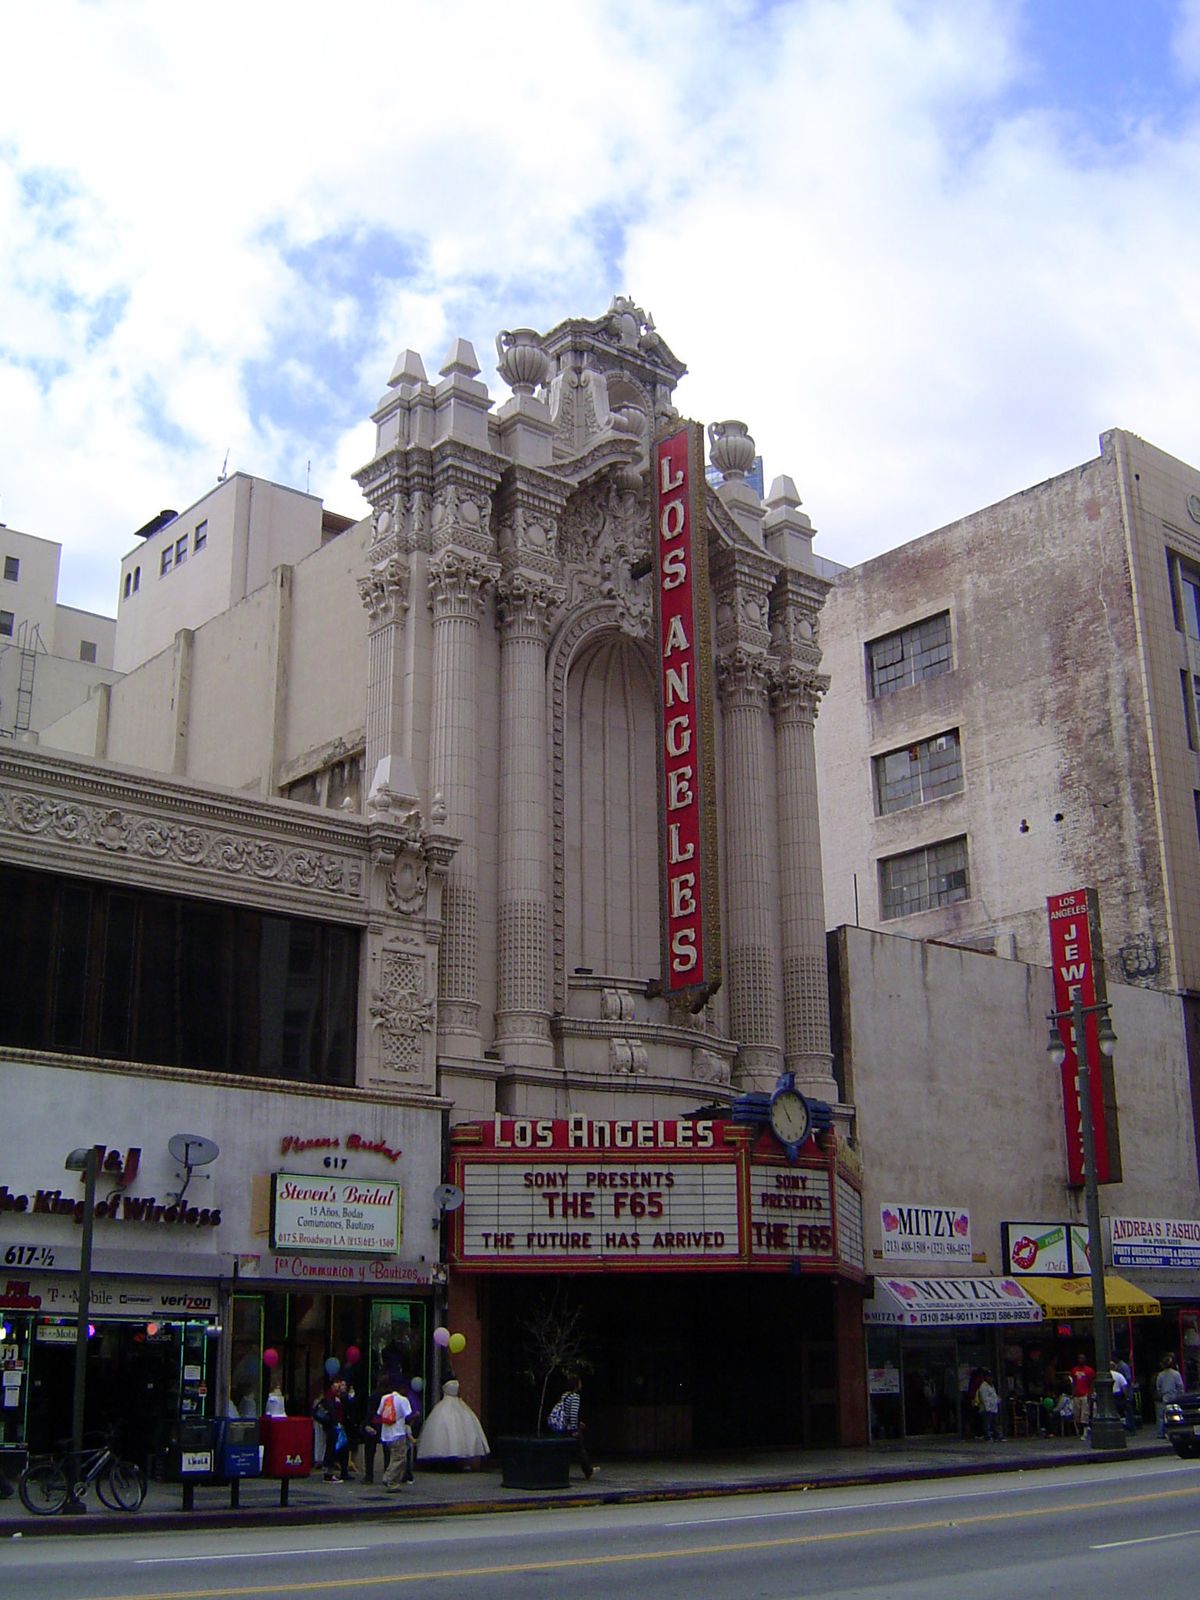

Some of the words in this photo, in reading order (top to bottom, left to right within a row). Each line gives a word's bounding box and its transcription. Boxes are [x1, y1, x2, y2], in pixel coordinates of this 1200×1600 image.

[659, 455, 688, 592] LOS
[663, 614, 698, 974] ANGELES
[1059, 896, 1075, 907] LOS
[1050, 904, 1086, 920] ANGELES
[494, 1111, 553, 1148] LOS
[569, 1113, 714, 1148] ANGELES
[323, 1157, 348, 1170] 617
[523, 1172, 569, 1189] SONY
[586, 1172, 675, 1188] PRESENTS
[774, 1174, 808, 1190] SONY
[280, 1182, 337, 1202] Steven's
[343, 1185, 395, 1206] Bridal
[761, 1192, 823, 1211] PRESENTS
[123, 1197, 221, 1226] Wireless
[309, 1207, 318, 1216] 15
[342, 1208, 364, 1219] Bodas
[542, 1192, 595, 1218] THE
[613, 1192, 664, 1218] F65
[898, 1208, 956, 1238] MITZY
[1113, 1219, 1162, 1240] ANDREA'S
[481, 1232, 516, 1249] THE
[527, 1232, 592, 1249] FUTURE
[605, 1232, 641, 1249] HAS
[654, 1232, 726, 1249] ARRIVED
[752, 1222, 789, 1248] THE
[797, 1223, 832, 1251] F65
[910, 1280, 1004, 1300] MITZY
[161, 1294, 212, 1308] verizon
[871, 1312, 896, 1321] MITZY
[920, 1311, 938, 1323] (310)
[980, 1310, 997, 1322] (323)
